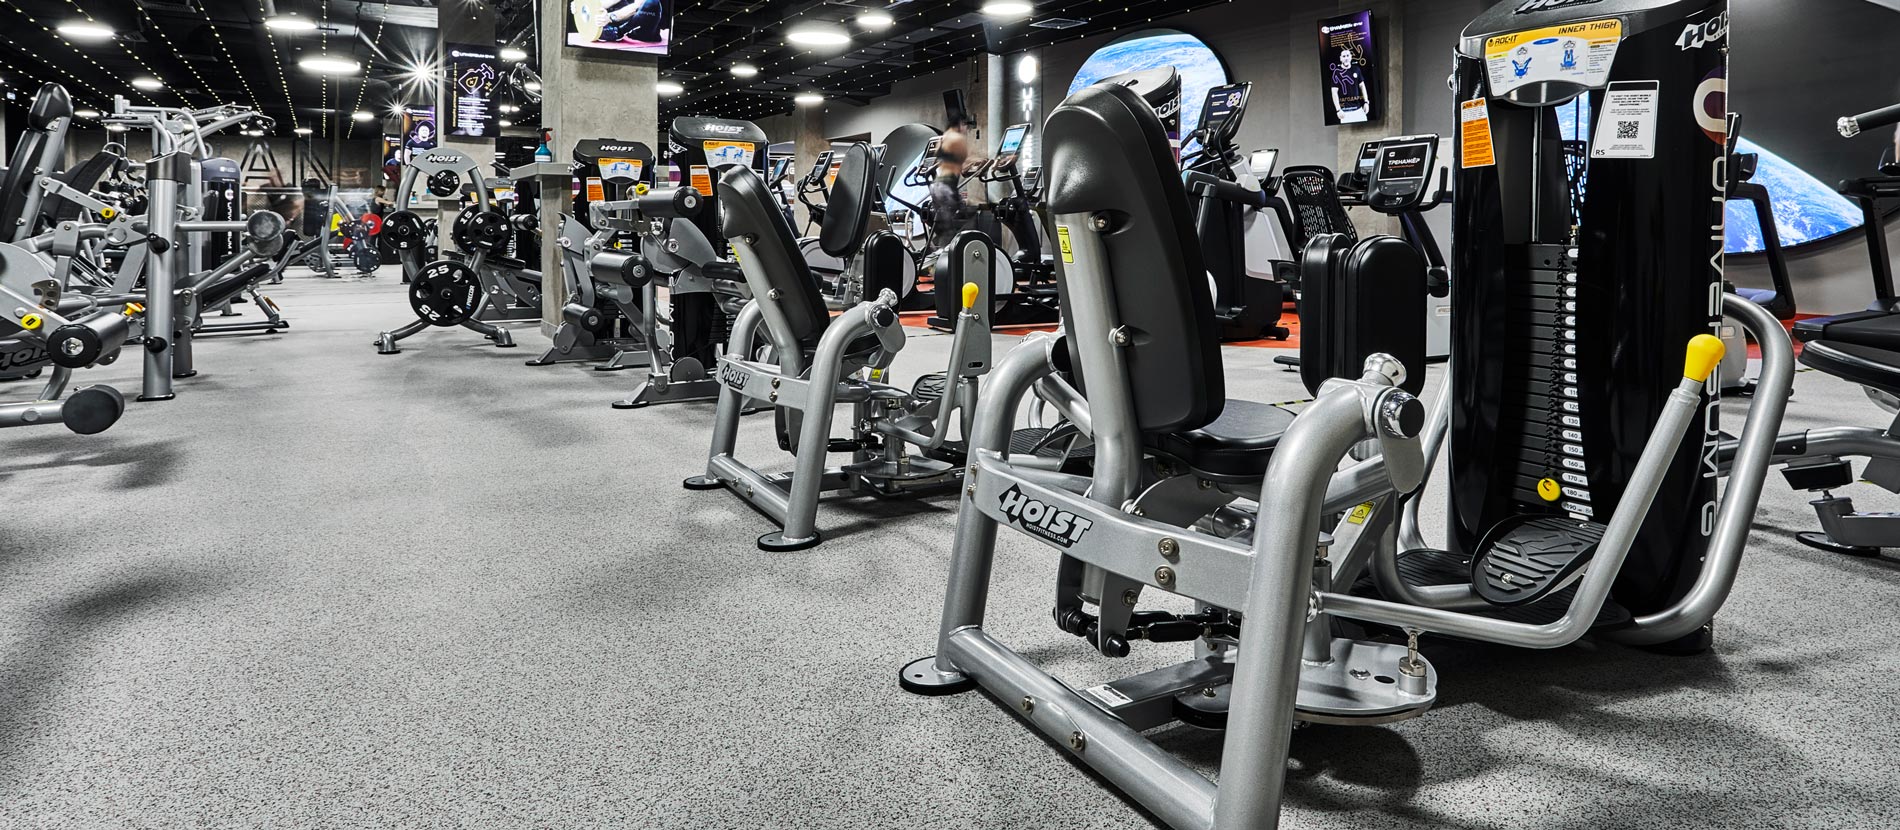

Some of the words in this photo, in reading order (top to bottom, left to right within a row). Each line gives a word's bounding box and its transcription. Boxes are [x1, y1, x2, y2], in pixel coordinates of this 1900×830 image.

[1558, 25, 1586, 34] INNER
[1590, 21, 1617, 30] THIGH
[704, 124, 744, 134] HOIST
[427, 264, 449, 279] 25
[419, 304, 441, 321] 25
[722, 366, 750, 387] HOIST
[1566, 503, 1577, 511] 190
[1000, 489, 1094, 542] HOIST
[1026, 522, 1068, 544] HOISTFITNESS.COM
